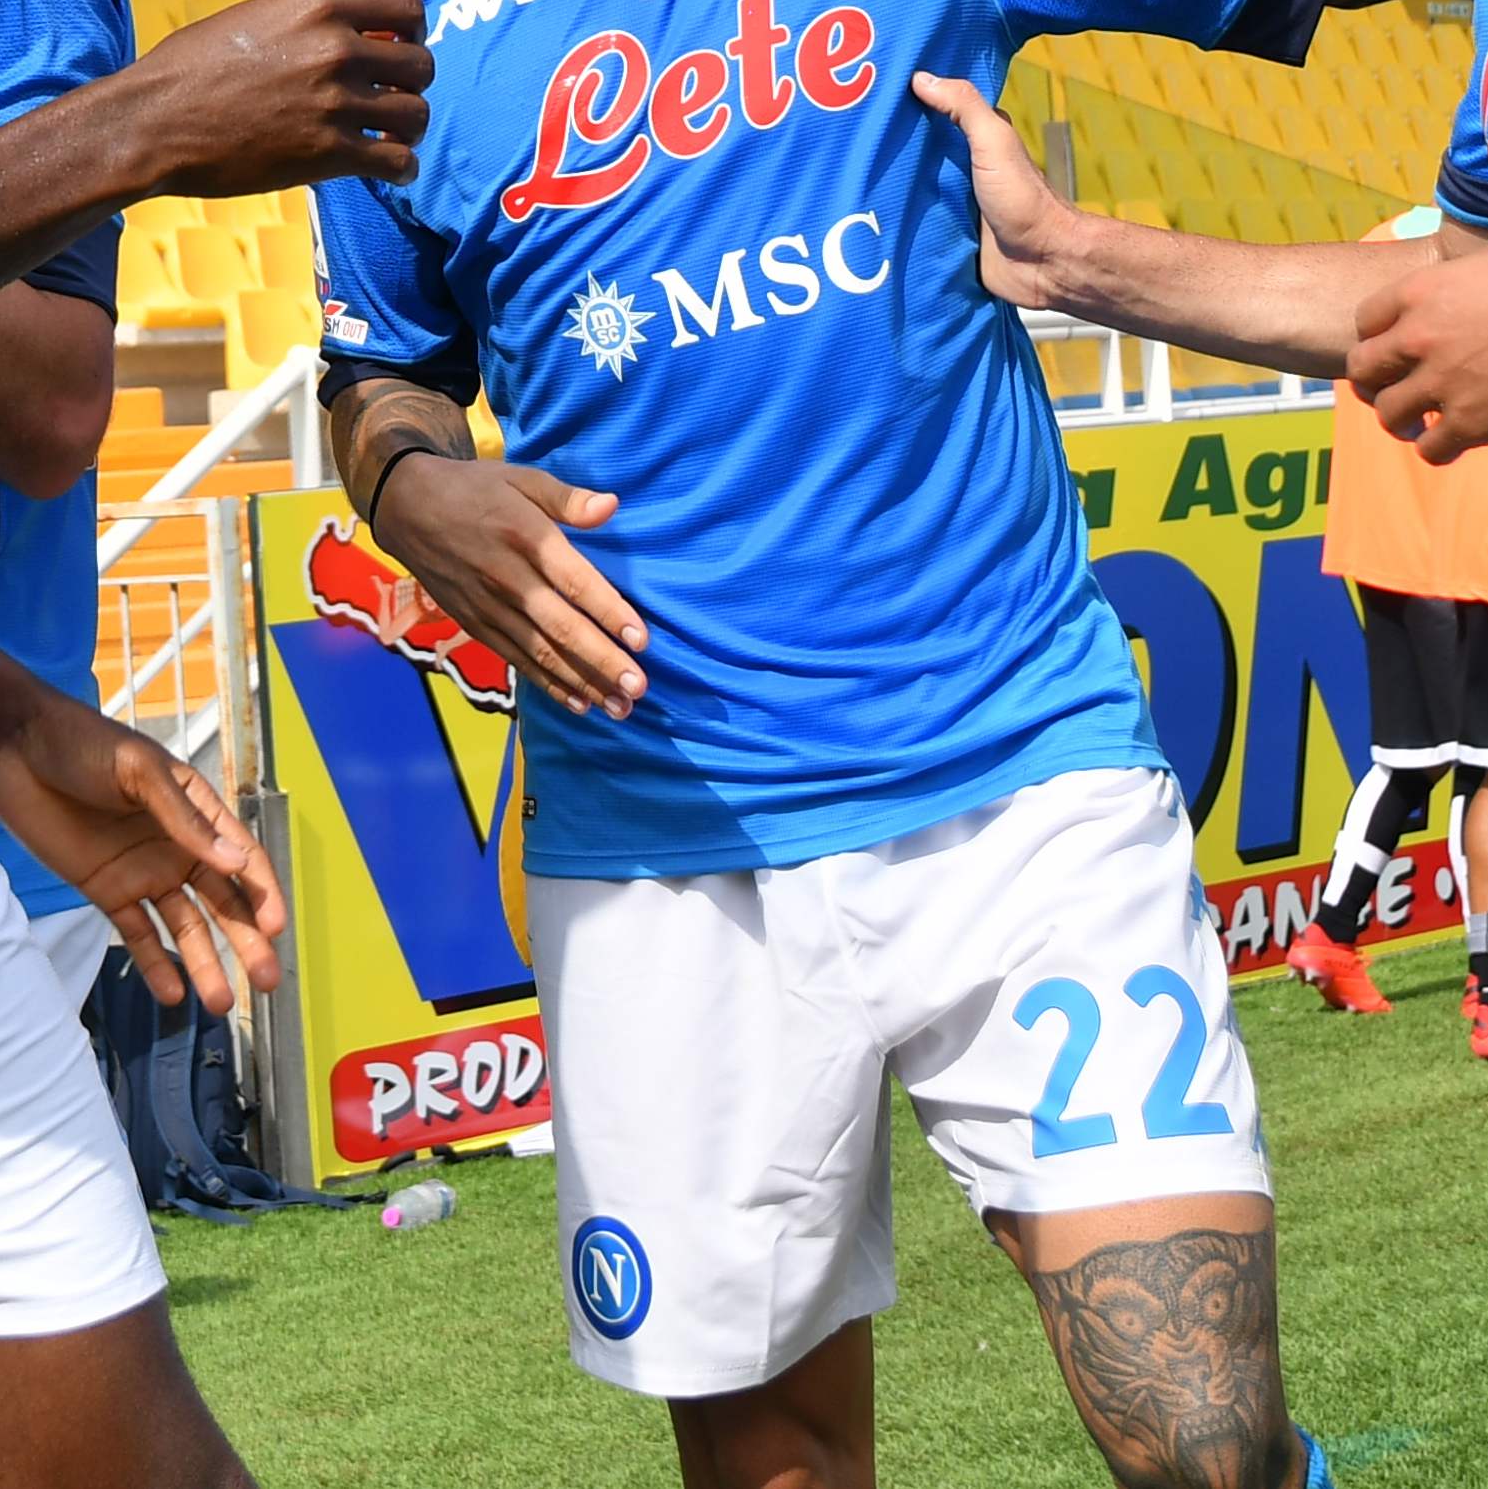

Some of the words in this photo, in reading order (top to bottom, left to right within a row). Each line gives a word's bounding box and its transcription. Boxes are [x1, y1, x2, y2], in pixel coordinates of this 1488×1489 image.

[652, 210, 890, 348] MSC
[1011, 964, 1236, 1160] 22
[587, 1245, 628, 1304] N
